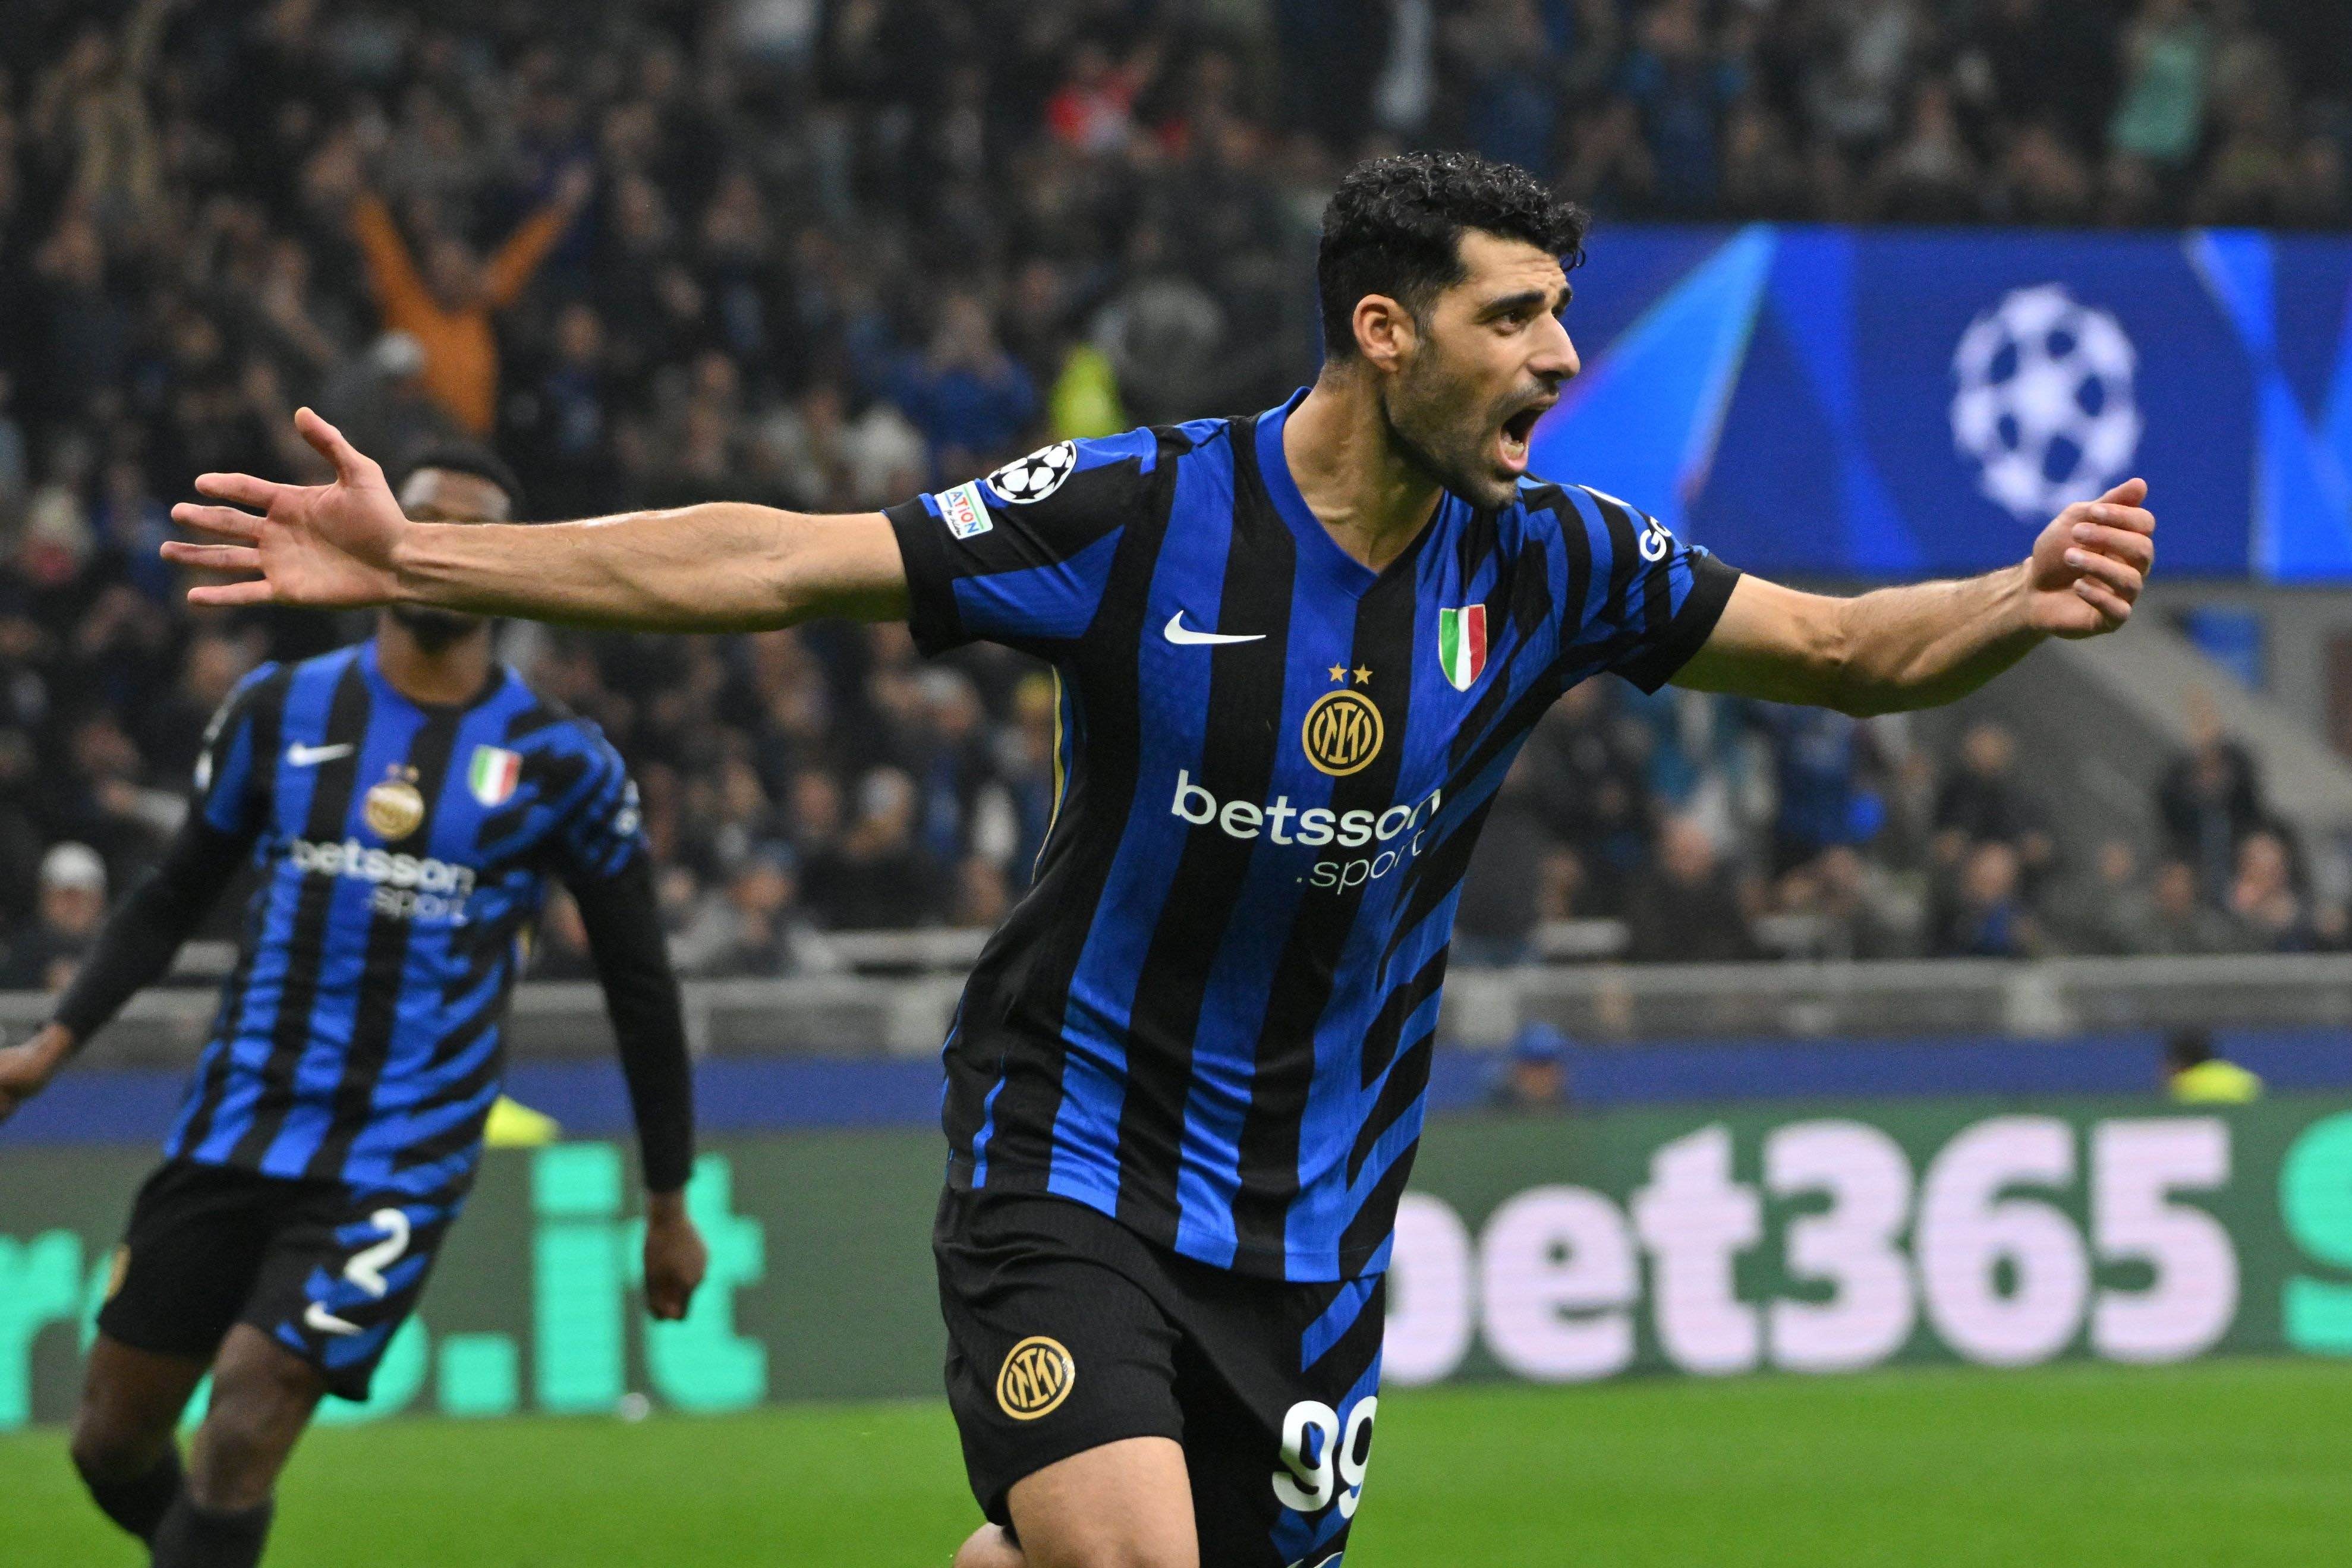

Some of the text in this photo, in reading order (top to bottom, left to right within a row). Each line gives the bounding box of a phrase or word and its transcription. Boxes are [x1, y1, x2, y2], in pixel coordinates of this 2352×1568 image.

[1171, 769, 1441, 847] betsson
[291, 835, 476, 896] betsson
[343, 1207, 411, 1298] 2
[1272, 1395, 1378, 1519] 99
